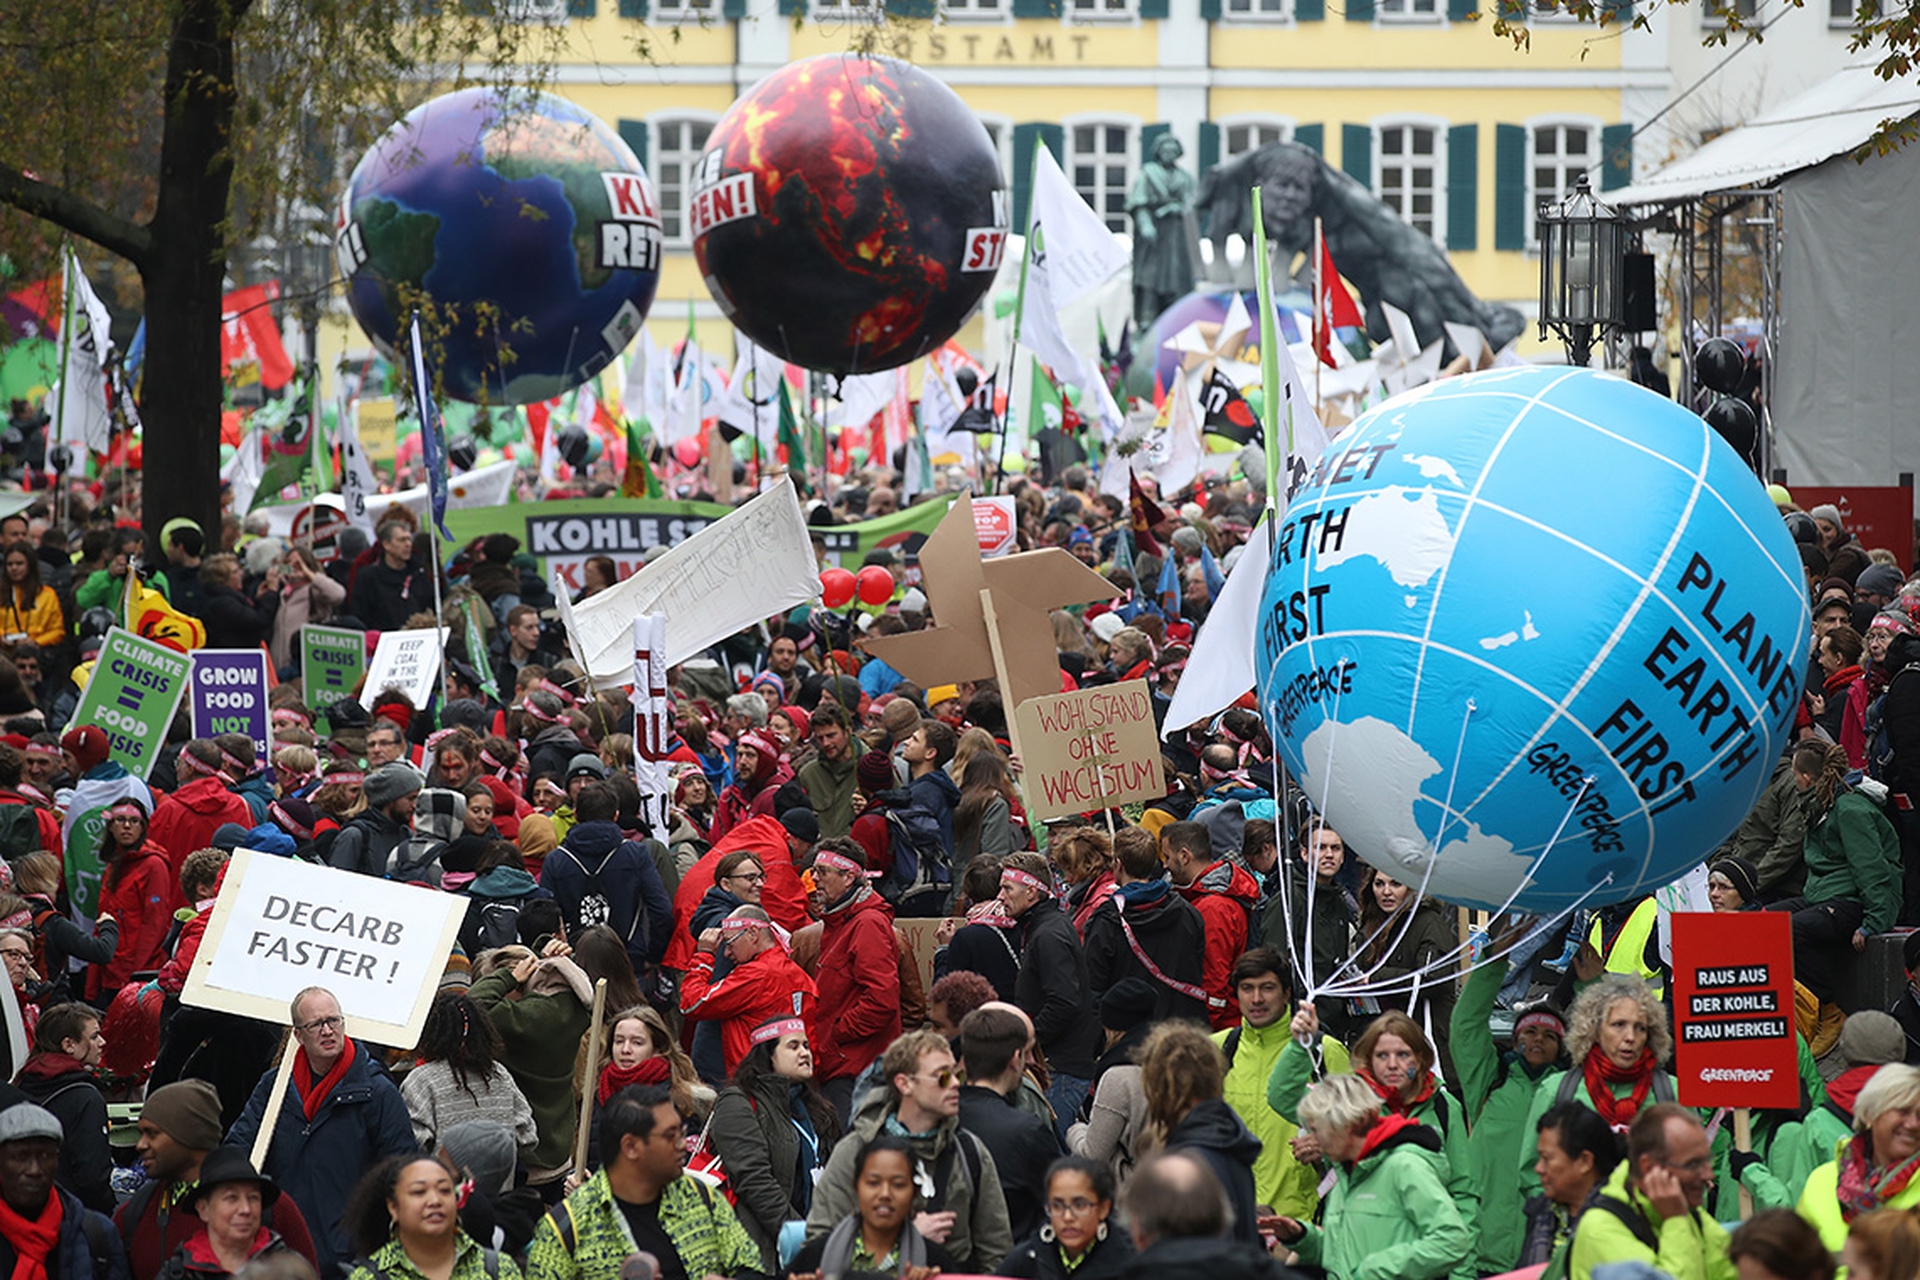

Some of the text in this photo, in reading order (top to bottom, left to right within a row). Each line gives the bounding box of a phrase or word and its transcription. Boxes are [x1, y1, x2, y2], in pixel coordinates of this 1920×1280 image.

[532, 518, 660, 552] KOHLE
[112, 638, 184, 678] CLIMATE
[307, 632, 359, 650] CLIMATE
[312, 649, 355, 666] CRISIS
[111, 659, 171, 694] CRISIS
[199, 667, 257, 686] GROW
[205, 692, 255, 709] FOOD
[1036, 691, 1149, 733] WOHLSTAND
[1643, 626, 1759, 783] EARTH
[93, 704, 148, 738] FOOD
[211, 716, 251, 734] NOT
[1593, 698, 1697, 817] FIRST
[1041, 758, 1157, 806] WACHSTUM
[1527, 742, 1625, 853] GREENPEACE
[263, 895, 404, 946] DECARB
[247, 930, 375, 980] FASTER
[1698, 968, 1767, 986] RAUS AUS
[1692, 995, 1775, 1013] DER KOHLE,
[1685, 1021, 1784, 1039] FRAU MERKEL!
[1700, 1067, 1774, 1083] GREENPEACE
